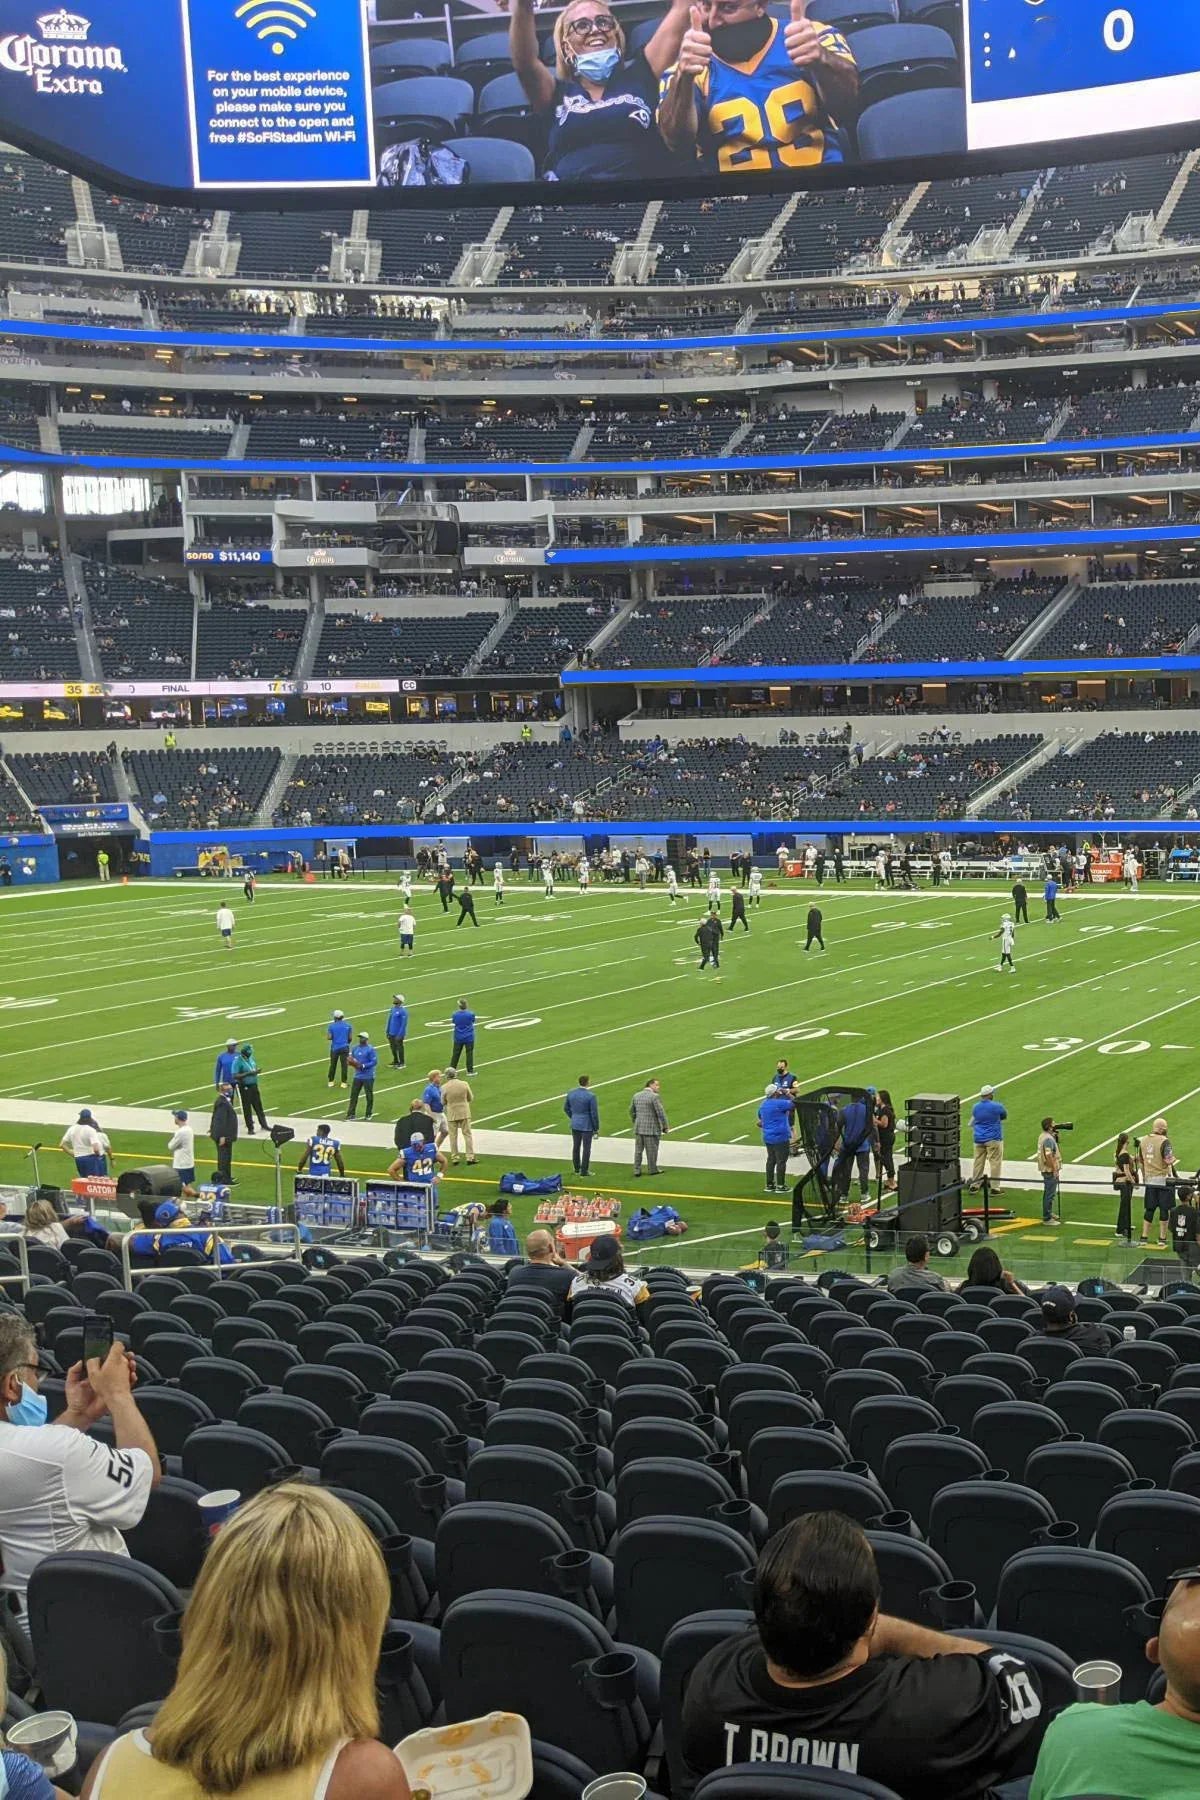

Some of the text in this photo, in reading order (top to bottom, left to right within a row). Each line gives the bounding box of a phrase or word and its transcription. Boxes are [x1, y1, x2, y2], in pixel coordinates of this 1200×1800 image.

[1103, 9, 1134, 51] 0
[0, 34, 125, 76] Corona
[35, 69, 104, 95] Extra
[207, 69, 350, 83] For the best experience
[212, 85, 348, 99] on your mobile device,
[215, 101, 346, 115] please make sure you
[209, 115, 354, 129] connect to the open and
[209, 130, 356, 143] free #SoFiStadium Wi-Fi
[219, 551, 261, 563] $11,140
[161, 684, 190, 693] FINAL
[403, 681, 416, 689] CC
[312, 1143, 336, 1164] 30
[411, 1157, 433, 1177] 42
[750, 1727, 861, 1776] BROWN
